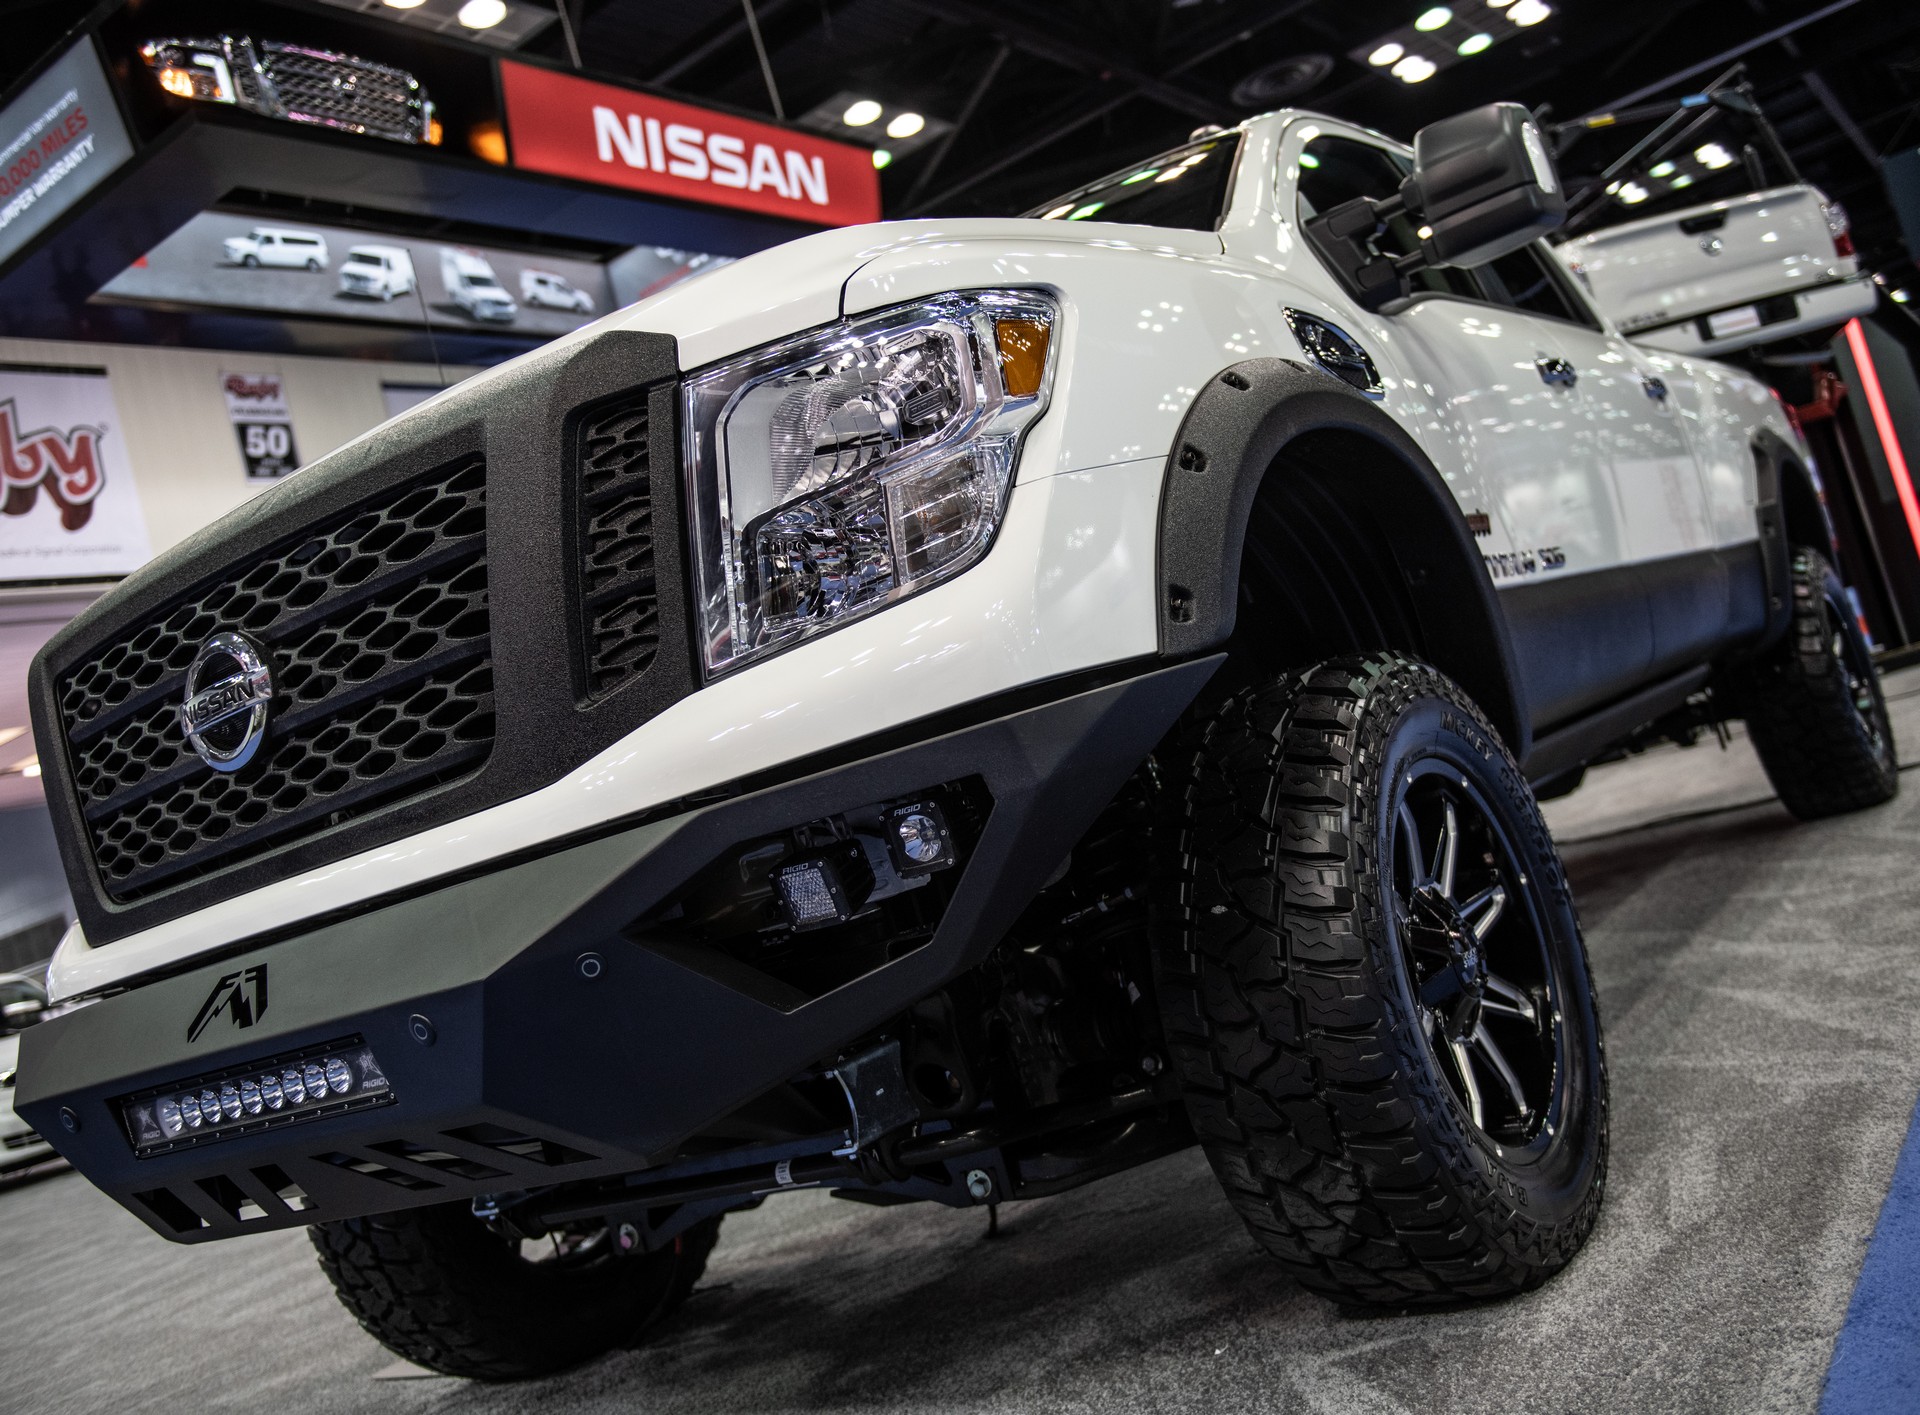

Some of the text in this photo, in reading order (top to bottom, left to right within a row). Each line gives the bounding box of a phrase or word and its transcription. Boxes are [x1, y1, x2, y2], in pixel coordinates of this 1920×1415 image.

[38, 106, 89, 160] MILES
[592, 105, 829, 205] NISSAN
[31, 134, 95, 198] WARRANTY
[246, 425, 289, 458] 50
[183, 678, 255, 725] NISSAN
[1440, 711, 1495, 761] MICKEY
[894, 803, 921, 816] RIGID
[1498, 766, 1566, 907] THOMPSON
[782, 862, 809, 875] RIGID
[362, 1077, 386, 1090] RIGID
[1483, 1155, 1529, 1207] BAJA
